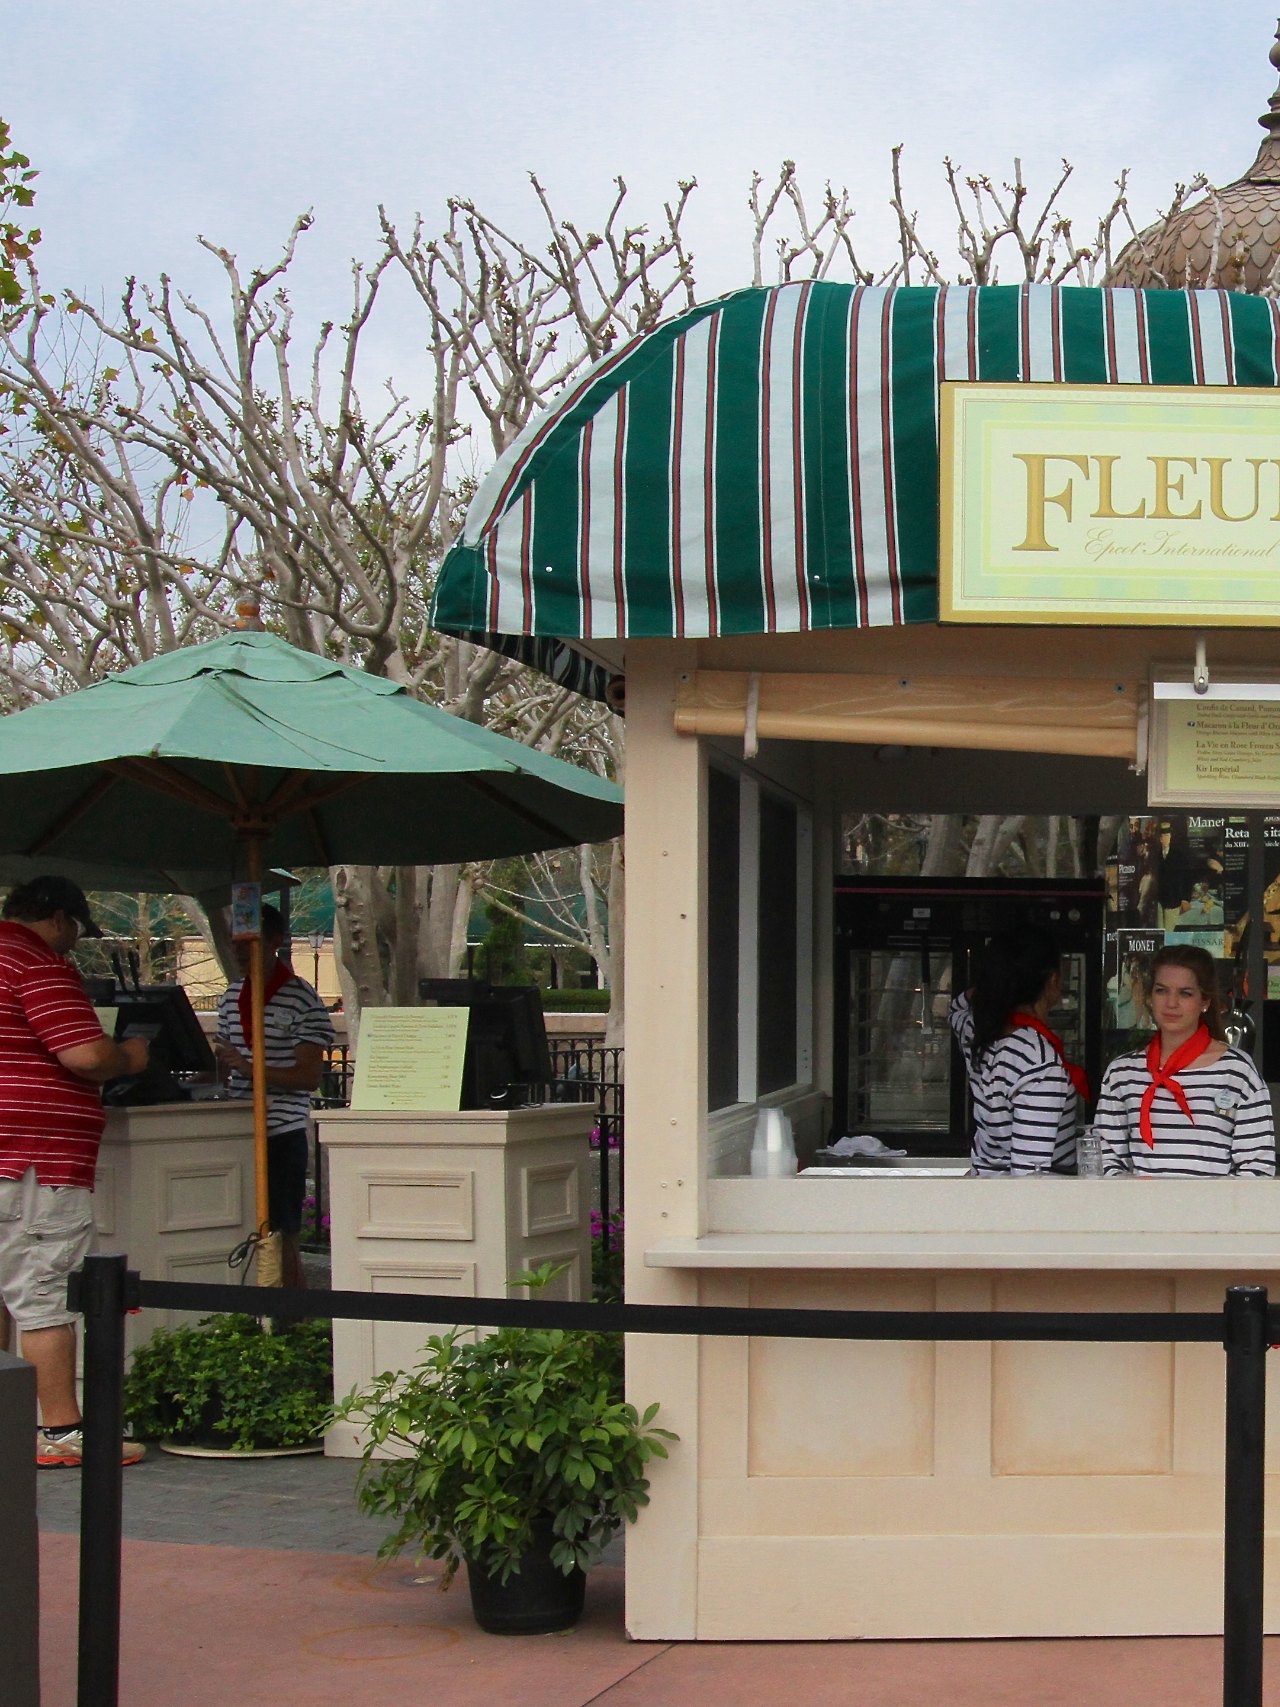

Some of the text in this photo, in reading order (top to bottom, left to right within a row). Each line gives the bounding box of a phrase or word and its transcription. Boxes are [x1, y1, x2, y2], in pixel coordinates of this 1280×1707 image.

[1196, 741, 1206, 749] La
[1206, 741, 1220, 749] Vie
[1196, 764, 1208, 773] Kir
[1188, 816, 1225, 828] Manet
[1128, 940, 1155, 952] MONET
